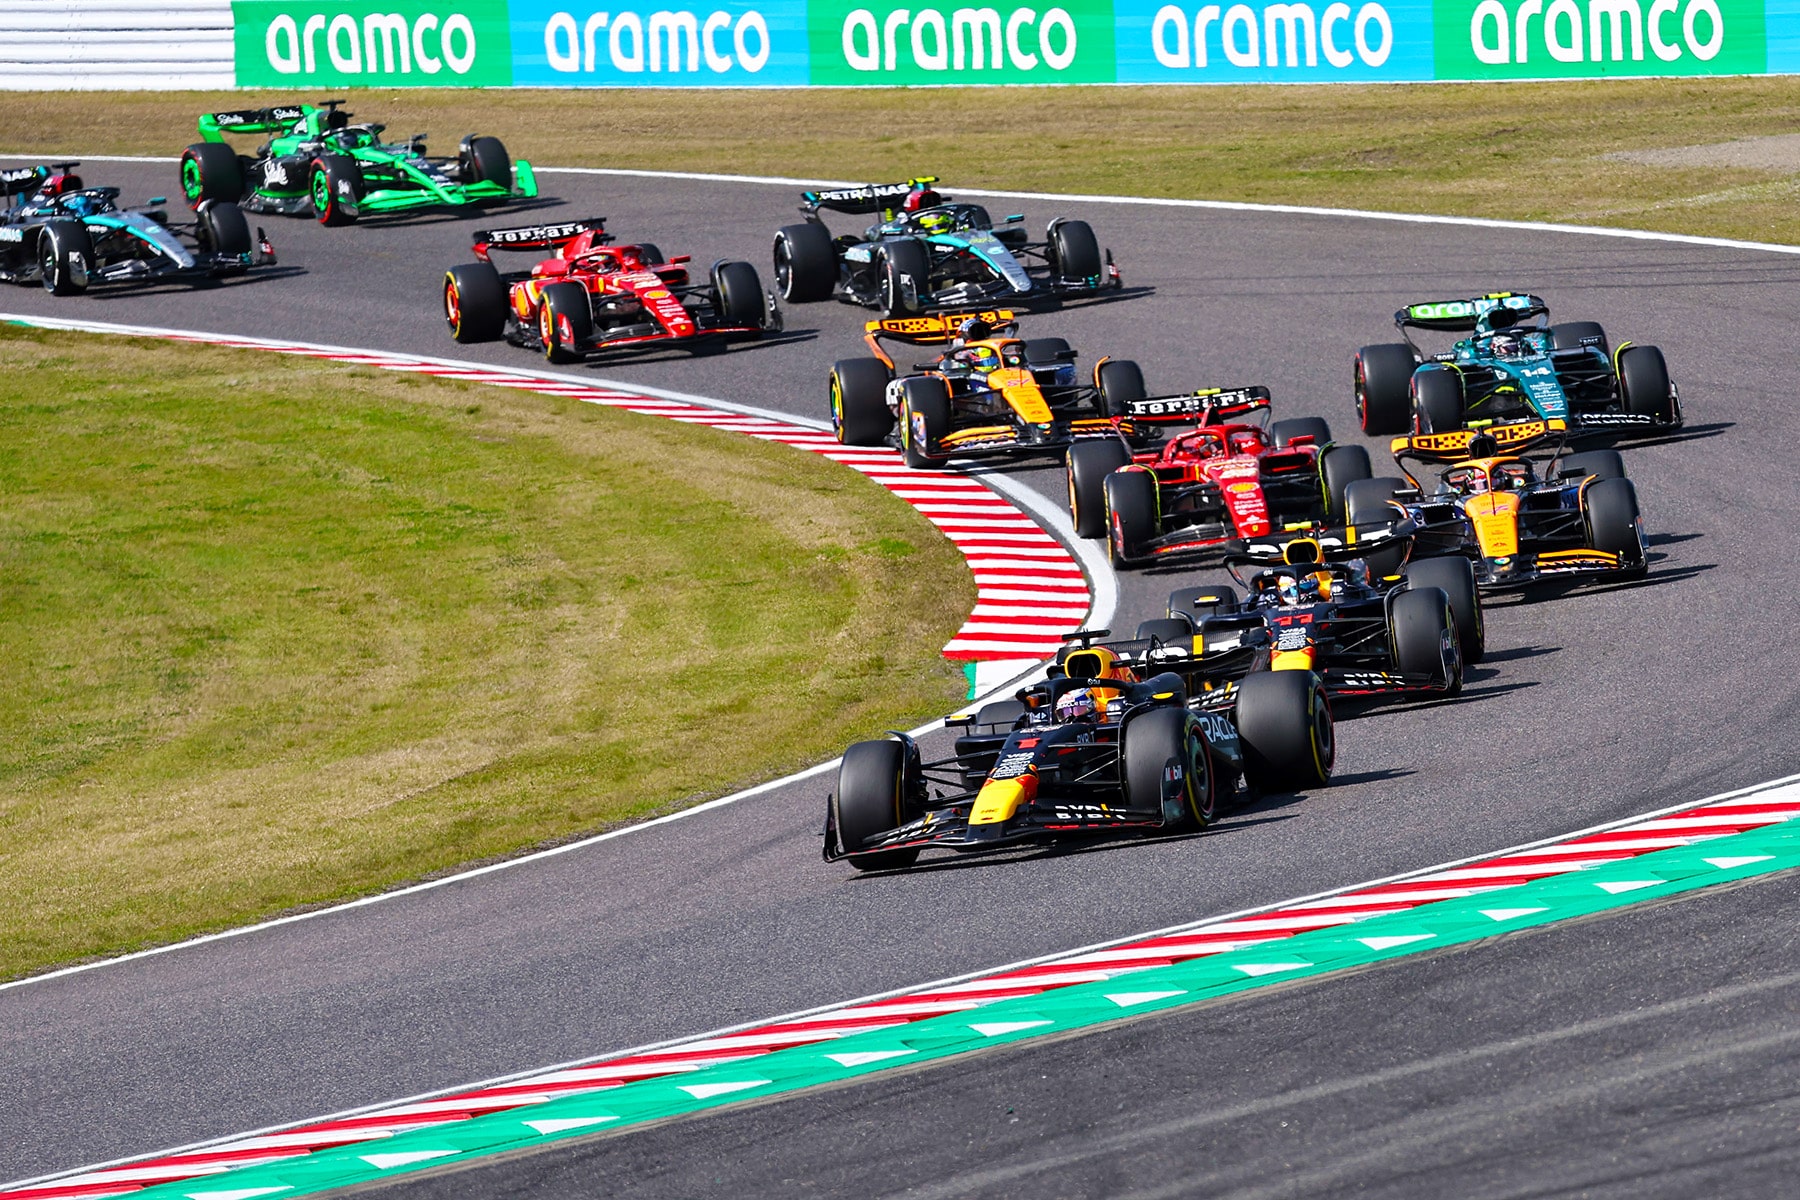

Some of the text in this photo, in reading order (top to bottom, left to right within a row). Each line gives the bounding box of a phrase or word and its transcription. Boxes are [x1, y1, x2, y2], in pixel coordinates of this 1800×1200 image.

[265, 13, 476, 74] aramco
[544, 10, 770, 73] aramco
[842, 7, 1077, 72] aramco
[1151, 3, 1393, 68] aramco
[1471, 0, 1724, 65] aramco
[819, 183, 911, 201] PETRONAS
[489, 223, 588, 242] Ferrari
[1127, 390, 1252, 415] Ferrari
[1165, 764, 1182, 782] Mobil
